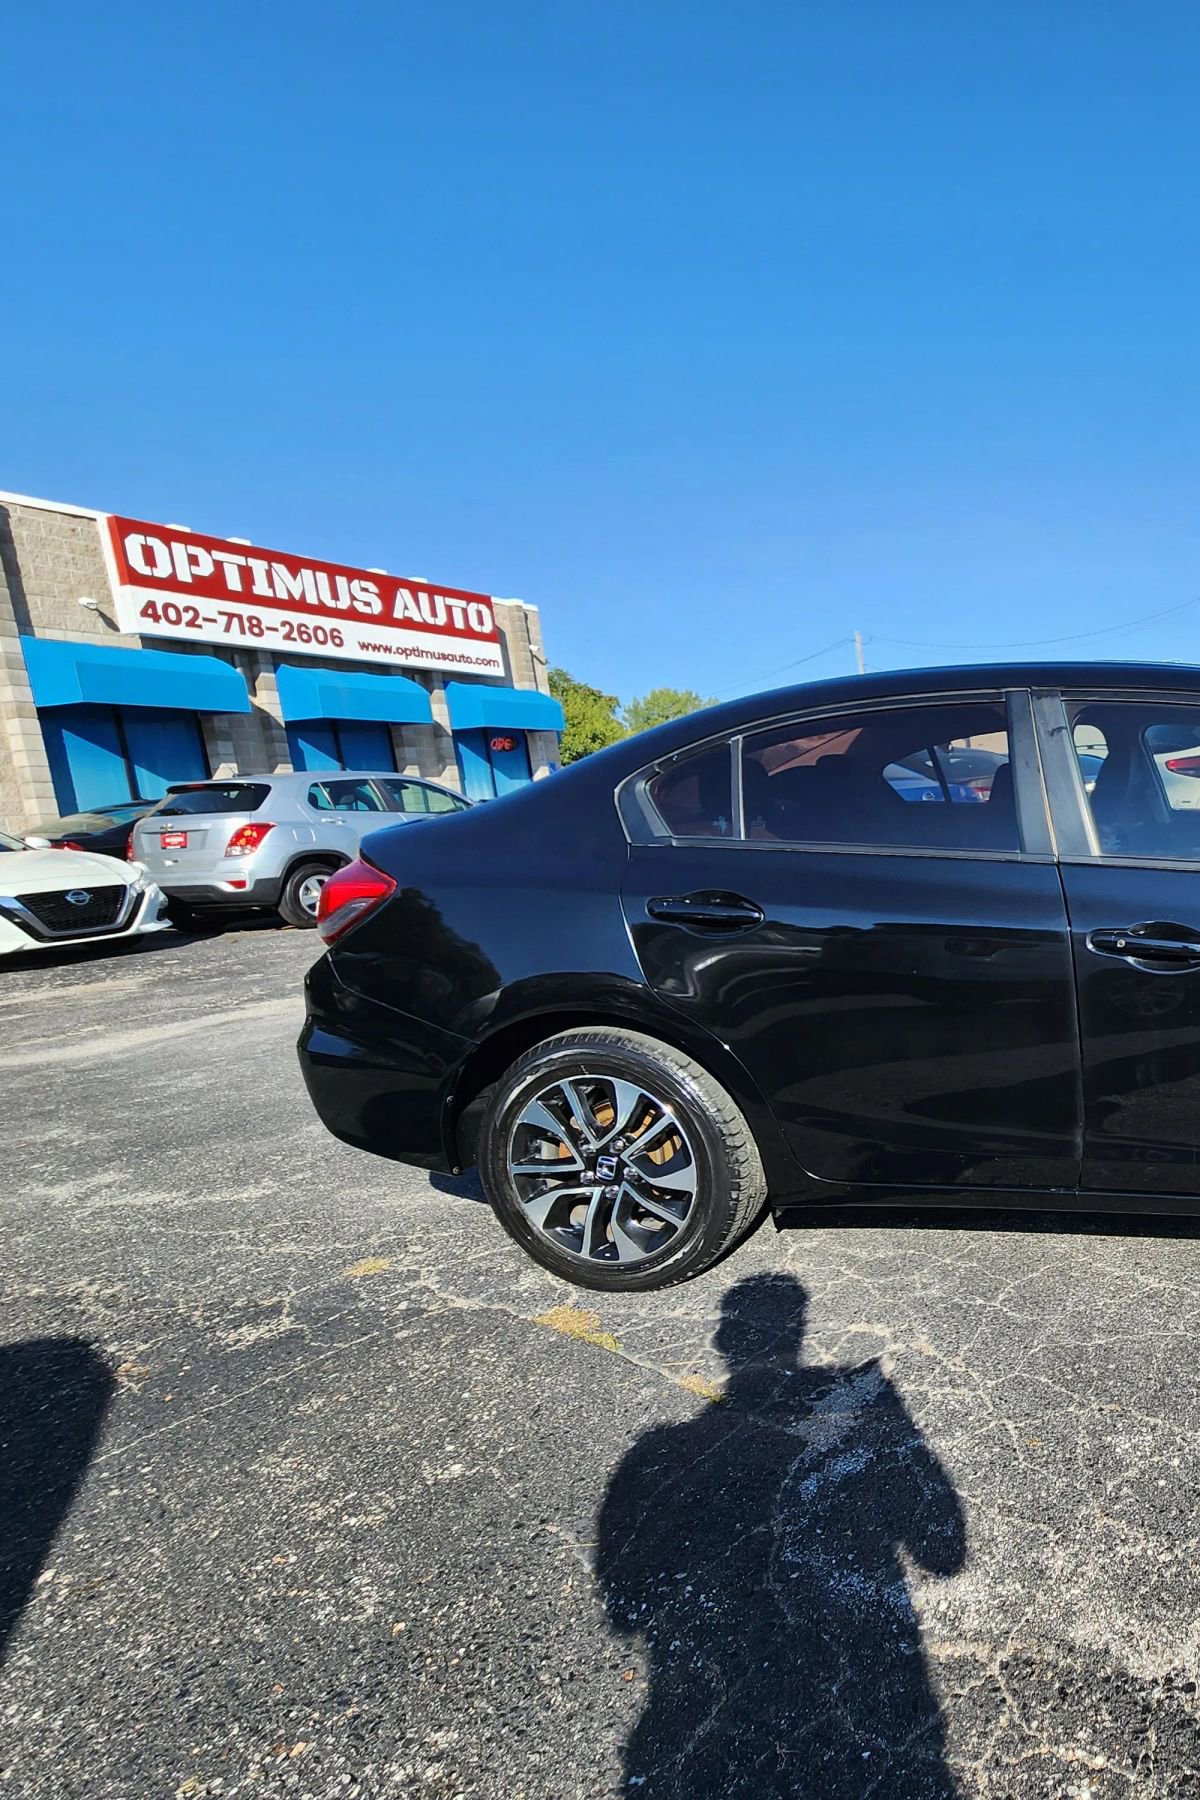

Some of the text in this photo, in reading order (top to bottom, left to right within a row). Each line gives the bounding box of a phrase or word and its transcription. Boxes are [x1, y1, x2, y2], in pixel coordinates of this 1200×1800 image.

[124, 533, 494, 634] OPTIMUS AUTO
[139, 599, 500, 668] 402-718-2606 www.optimusauto.com
[490, 736, 515, 752] OPE
